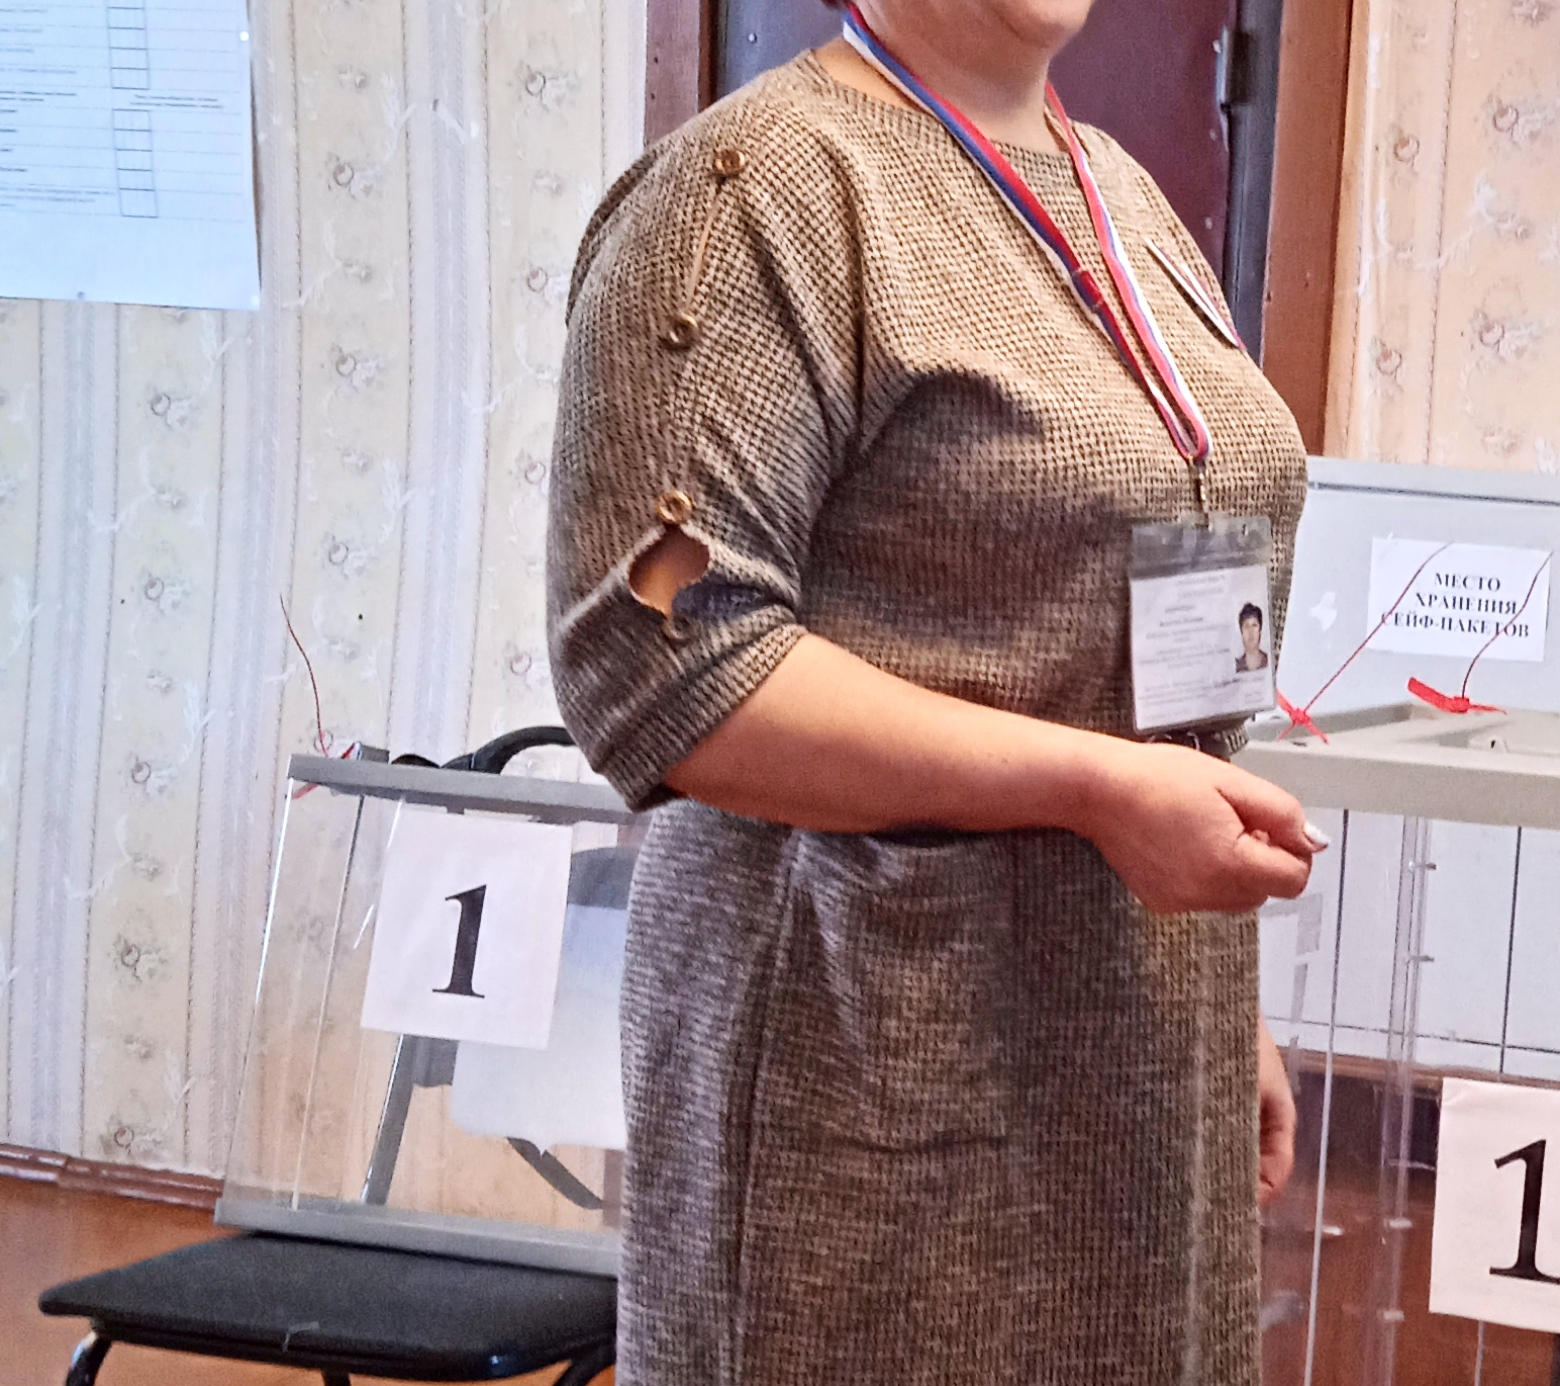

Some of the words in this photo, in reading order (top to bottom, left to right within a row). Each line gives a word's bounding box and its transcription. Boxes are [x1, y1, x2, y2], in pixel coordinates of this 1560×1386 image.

[1435, 572, 1501, 592] МЕСТО
[1416, 592, 1517, 615] ХРАНЕНИЯ
[1381, 610, 1529, 638] СЕЙФ-ПАКЕТОВ
[432, 884, 487, 999] 1
[1489, 1139, 1560, 1286] 1
